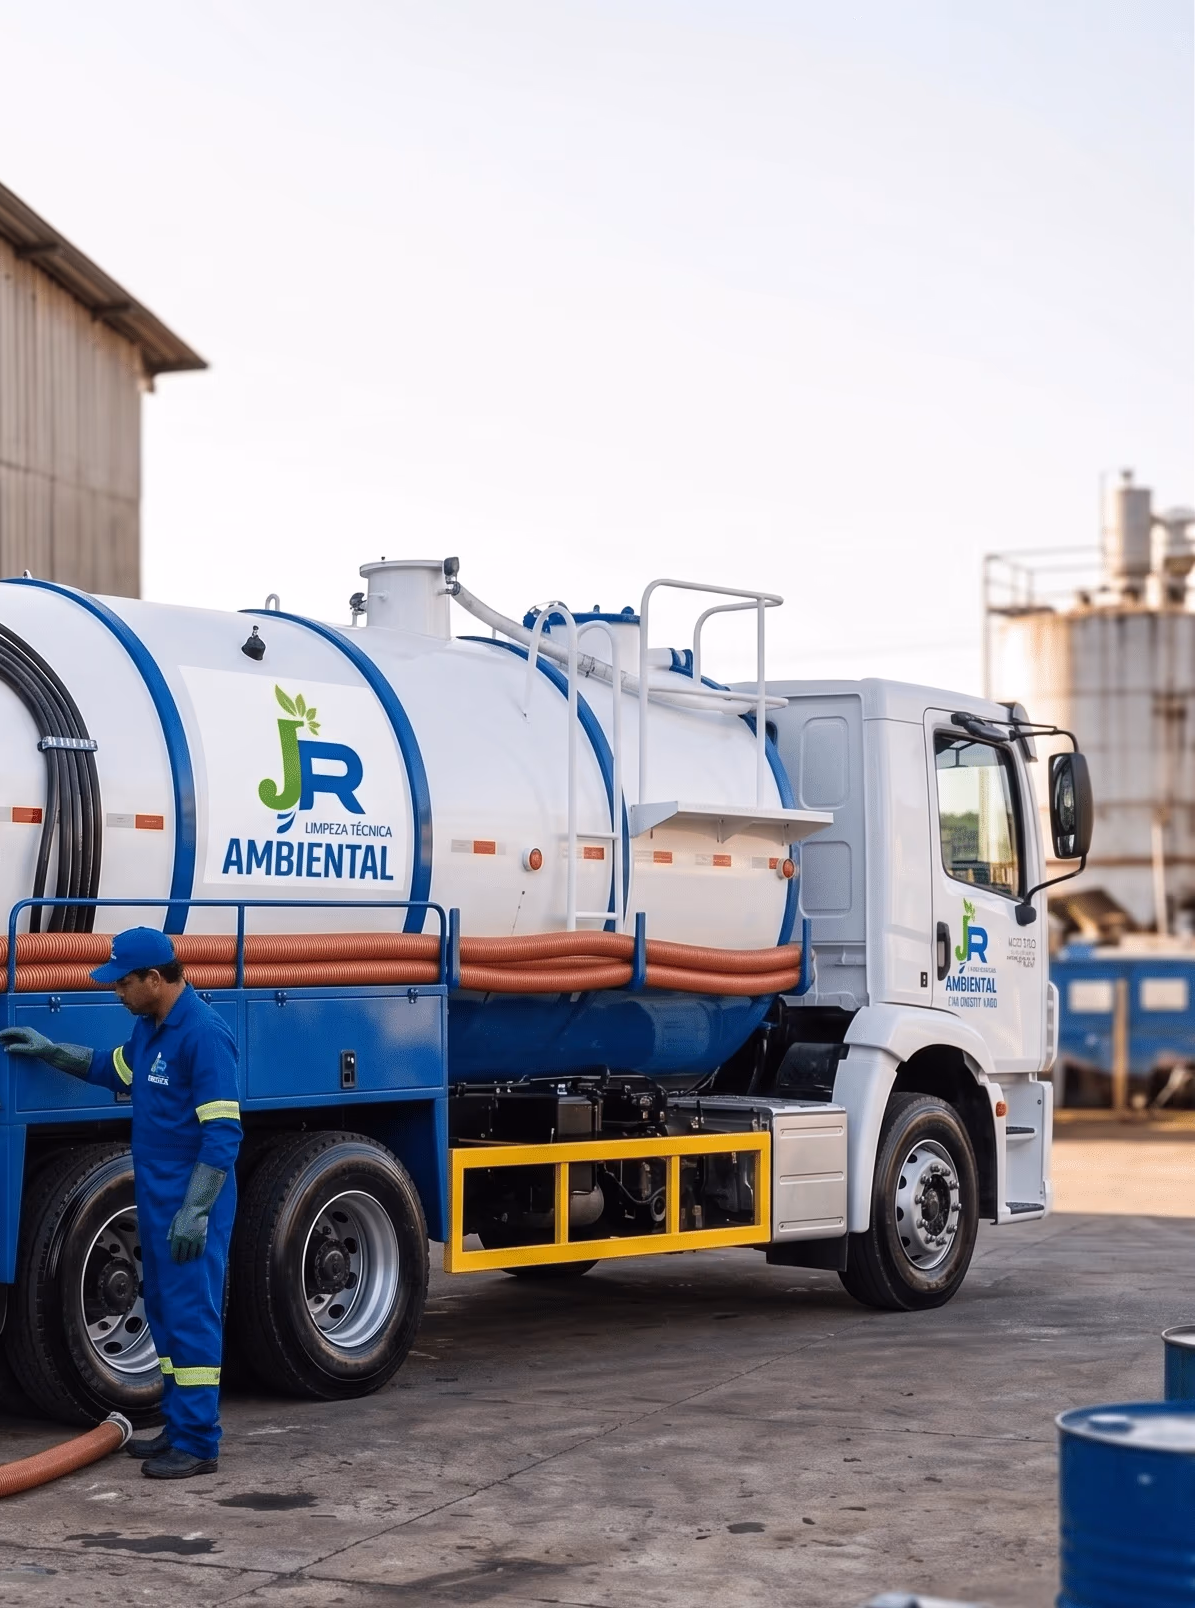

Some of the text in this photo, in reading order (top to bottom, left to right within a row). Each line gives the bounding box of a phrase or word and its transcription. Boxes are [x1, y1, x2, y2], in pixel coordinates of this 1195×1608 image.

[258, 718, 366, 815] JR
[305, 821, 392, 838] LIMPEZA TÉCNICA
[222, 837, 394, 881] AMBIENTAL
[955, 915, 989, 964] JR
[945, 975, 997, 993] AMBIENTAL
